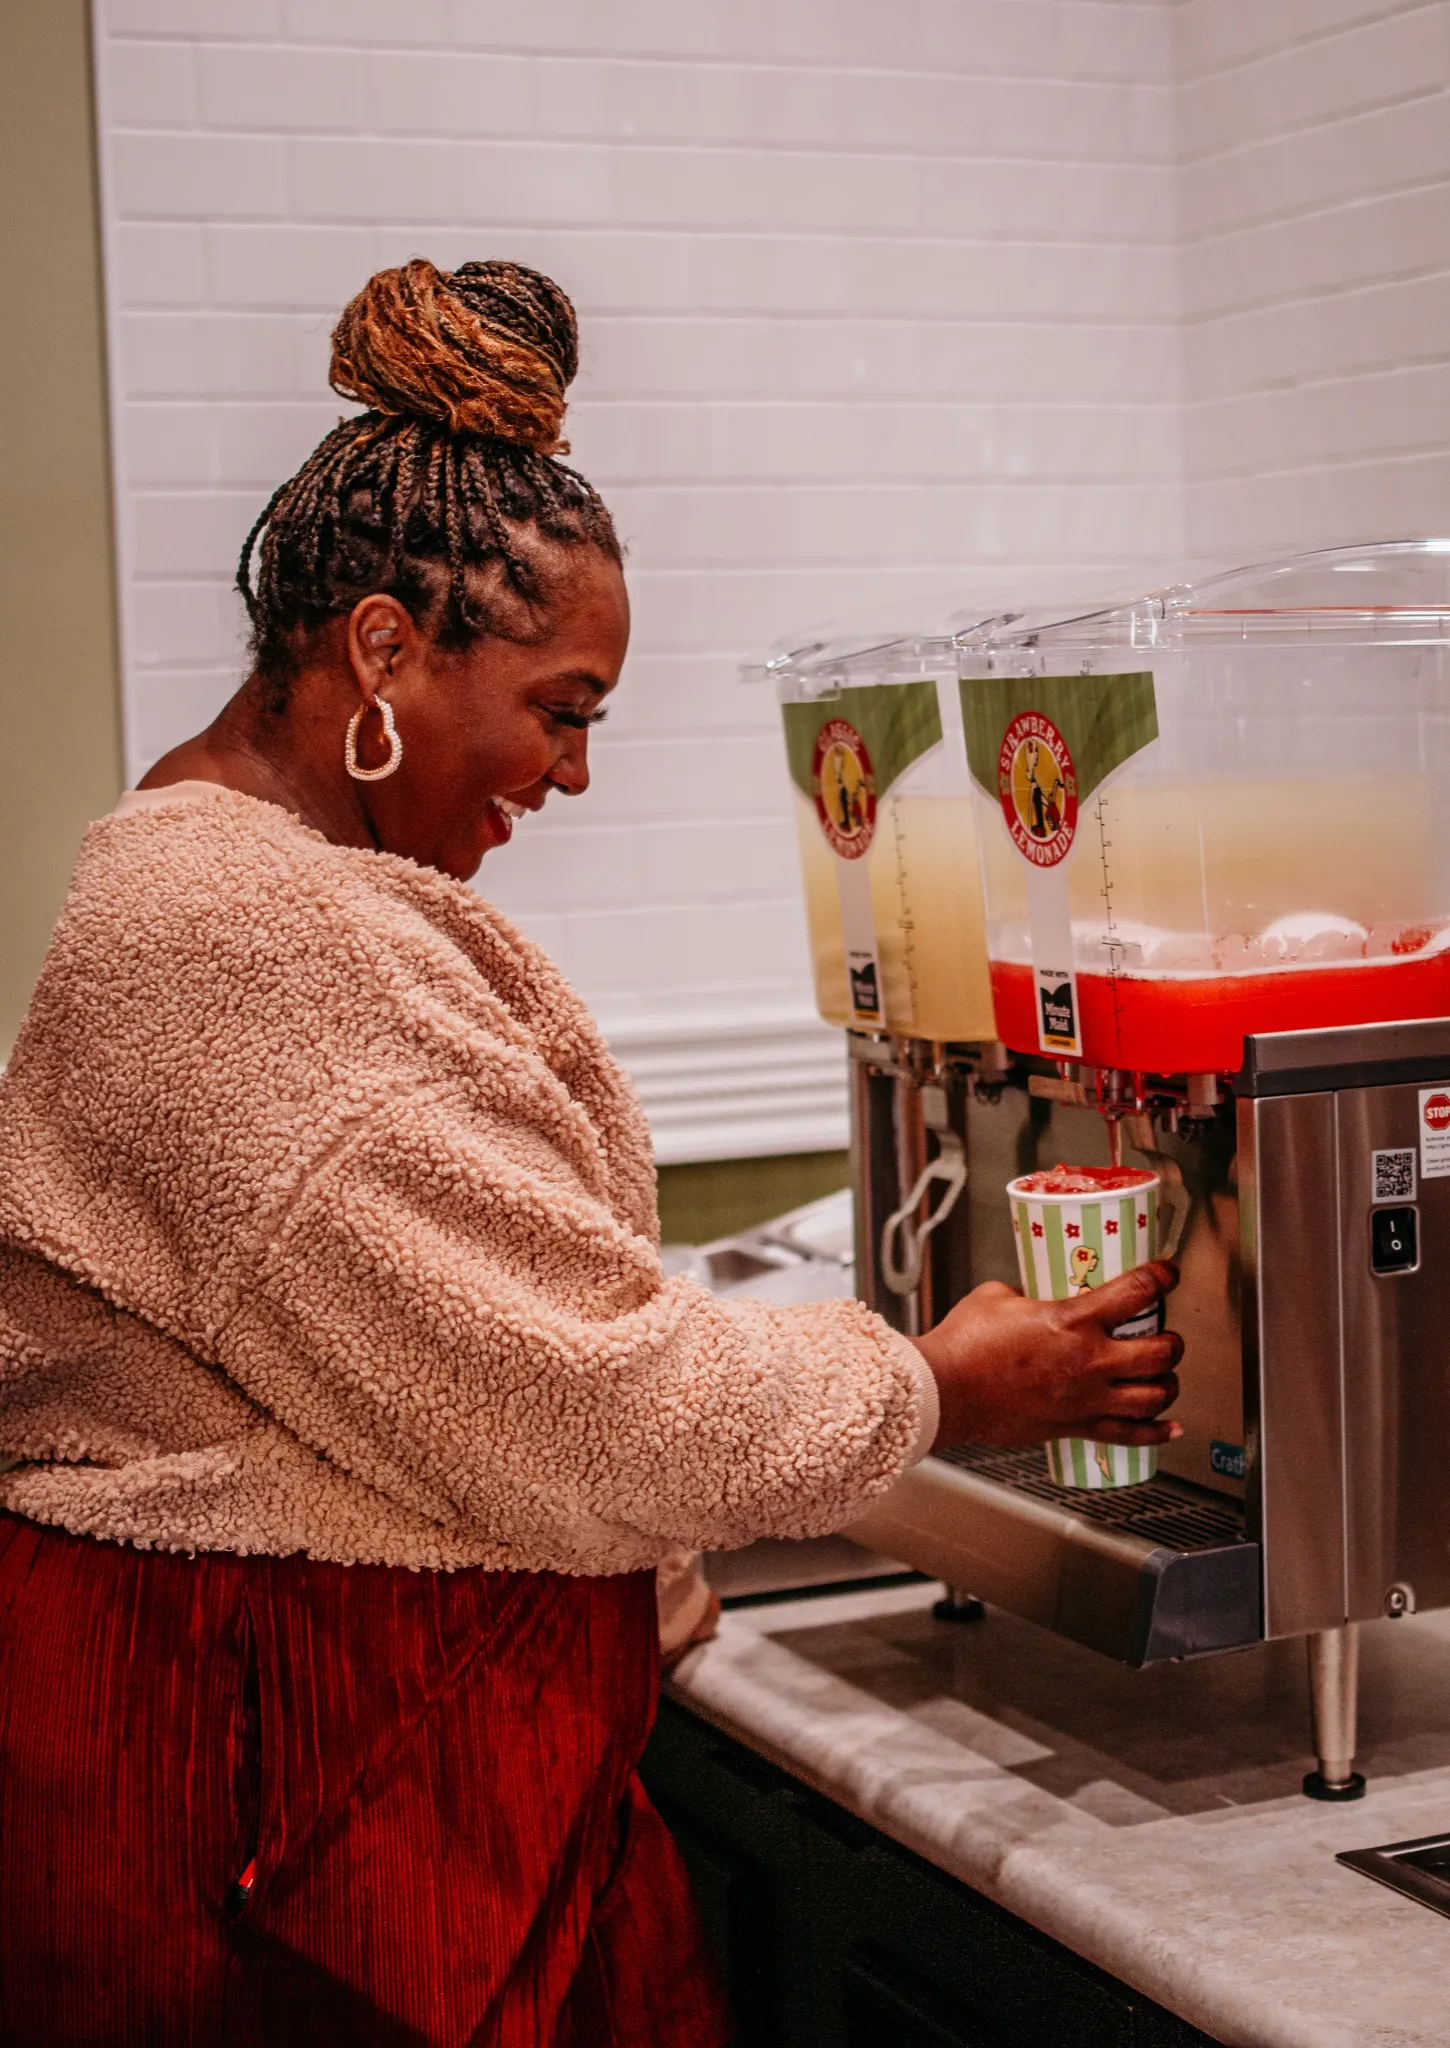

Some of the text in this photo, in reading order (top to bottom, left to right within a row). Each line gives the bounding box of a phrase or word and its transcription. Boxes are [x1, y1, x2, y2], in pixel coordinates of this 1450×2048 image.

[1000, 716, 1070, 770] STRAWBERRY
[1010, 820, 1074, 864] LEMONADE
[1426, 1105, 1450, 1120] STOP
